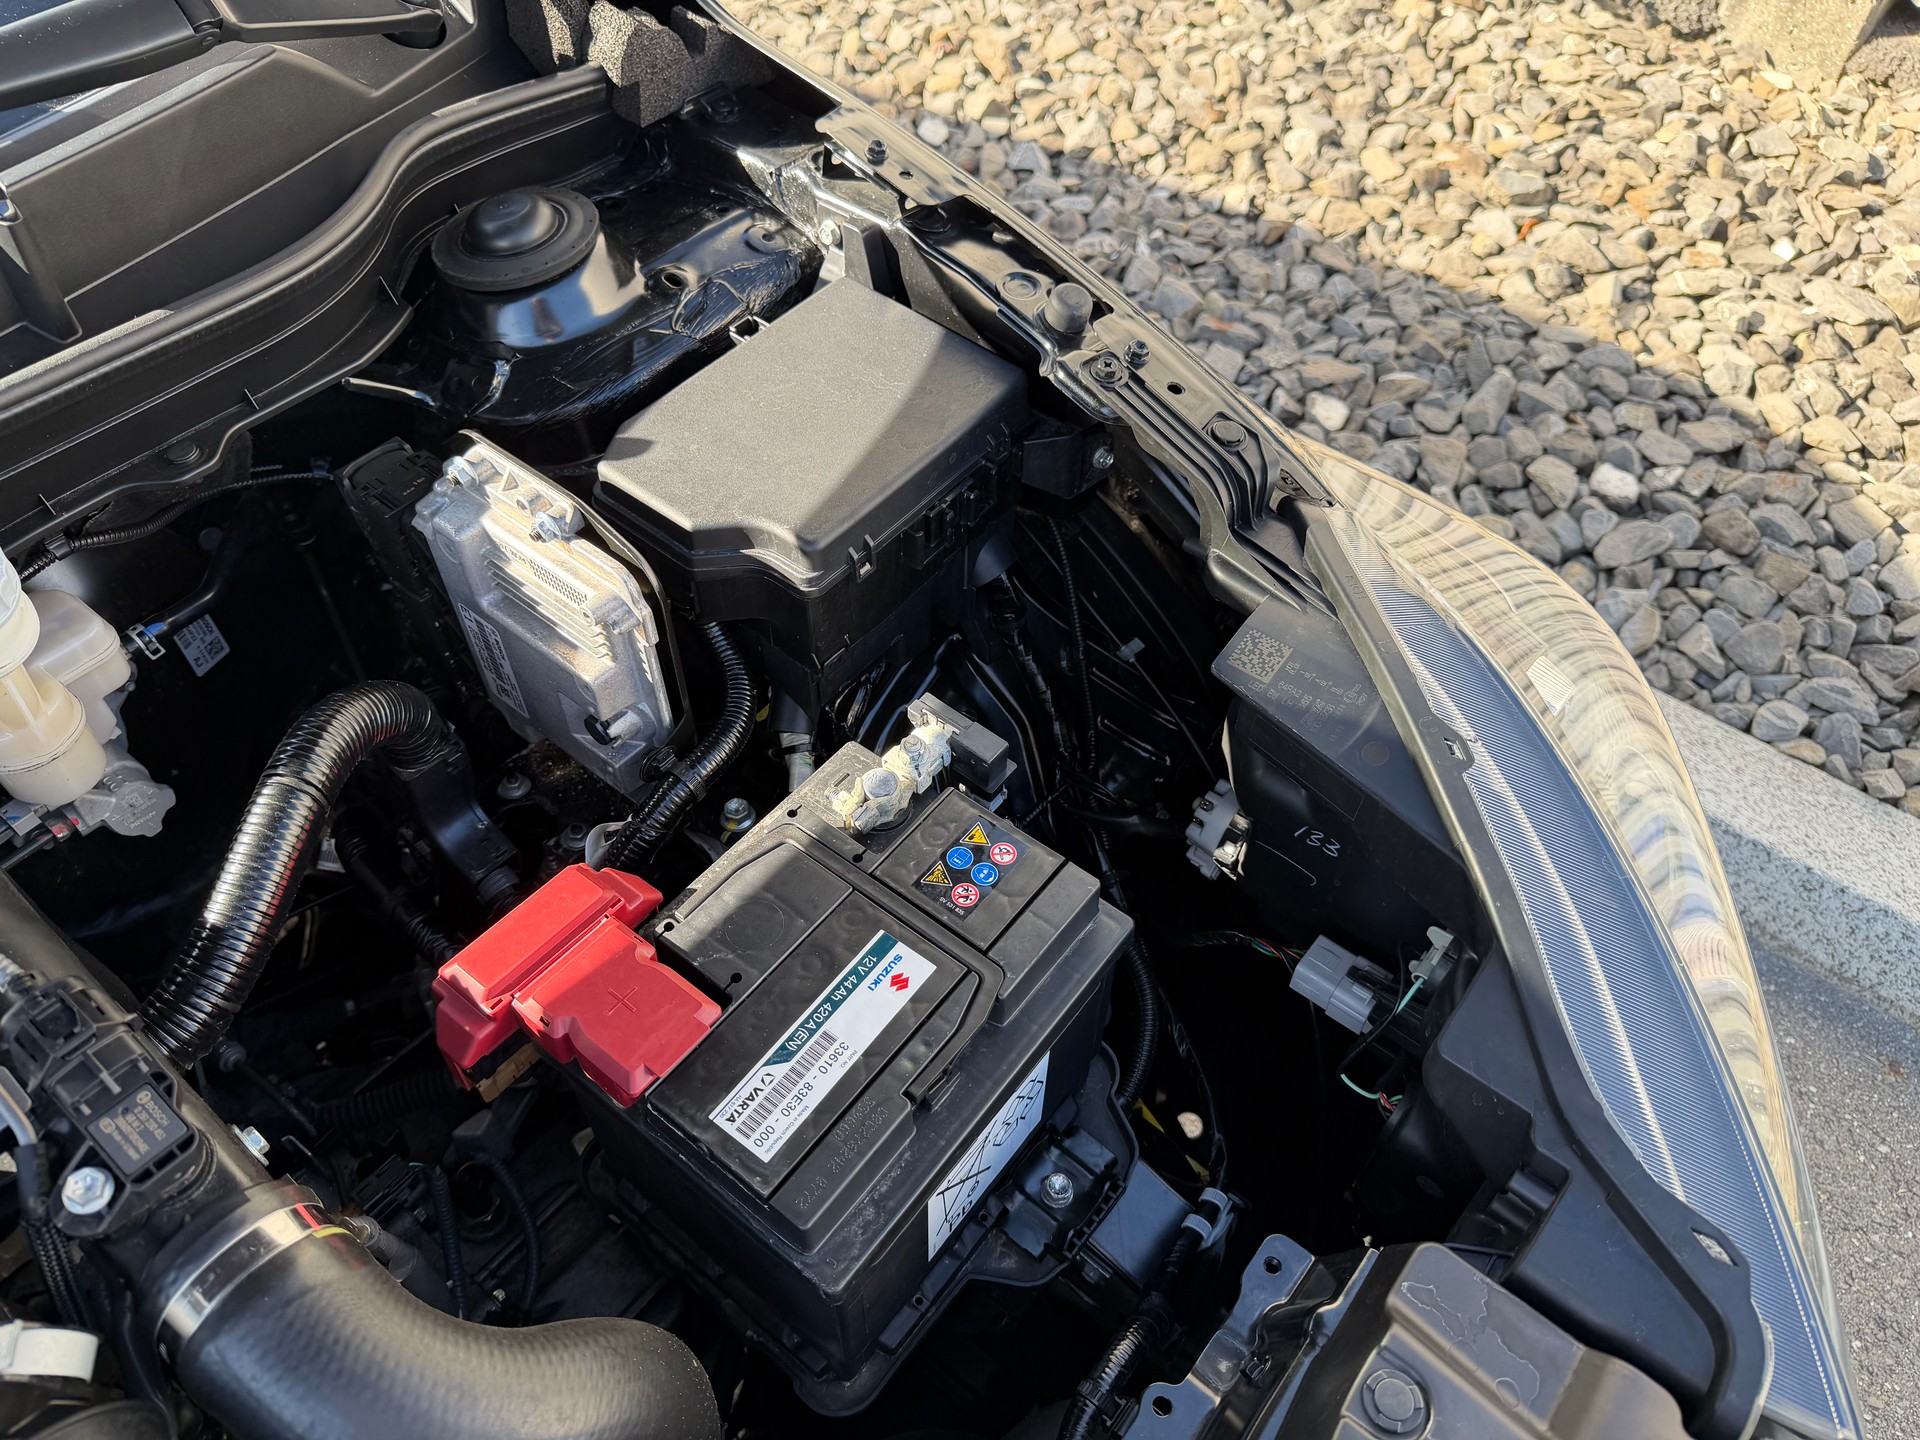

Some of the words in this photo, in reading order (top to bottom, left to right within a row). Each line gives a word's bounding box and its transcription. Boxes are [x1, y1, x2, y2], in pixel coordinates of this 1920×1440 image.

[1247, 679, 1264, 693] LED
[1293, 825, 1344, 858] 133
[866, 952, 904, 993] SUZUKI
[816, 1039, 852, 1077] 33610
[144, 1099, 171, 1128] BOSCH
[724, 1083, 765, 1127] VARTA
[778, 1080, 816, 1120] 83E30
[797, 1104, 810, 1118] Made
[751, 1123, 777, 1150] 000
[781, 1120, 796, 1136] Czech
[763, 1133, 784, 1156] Republic
[949, 1199, 973, 1233] Pb
